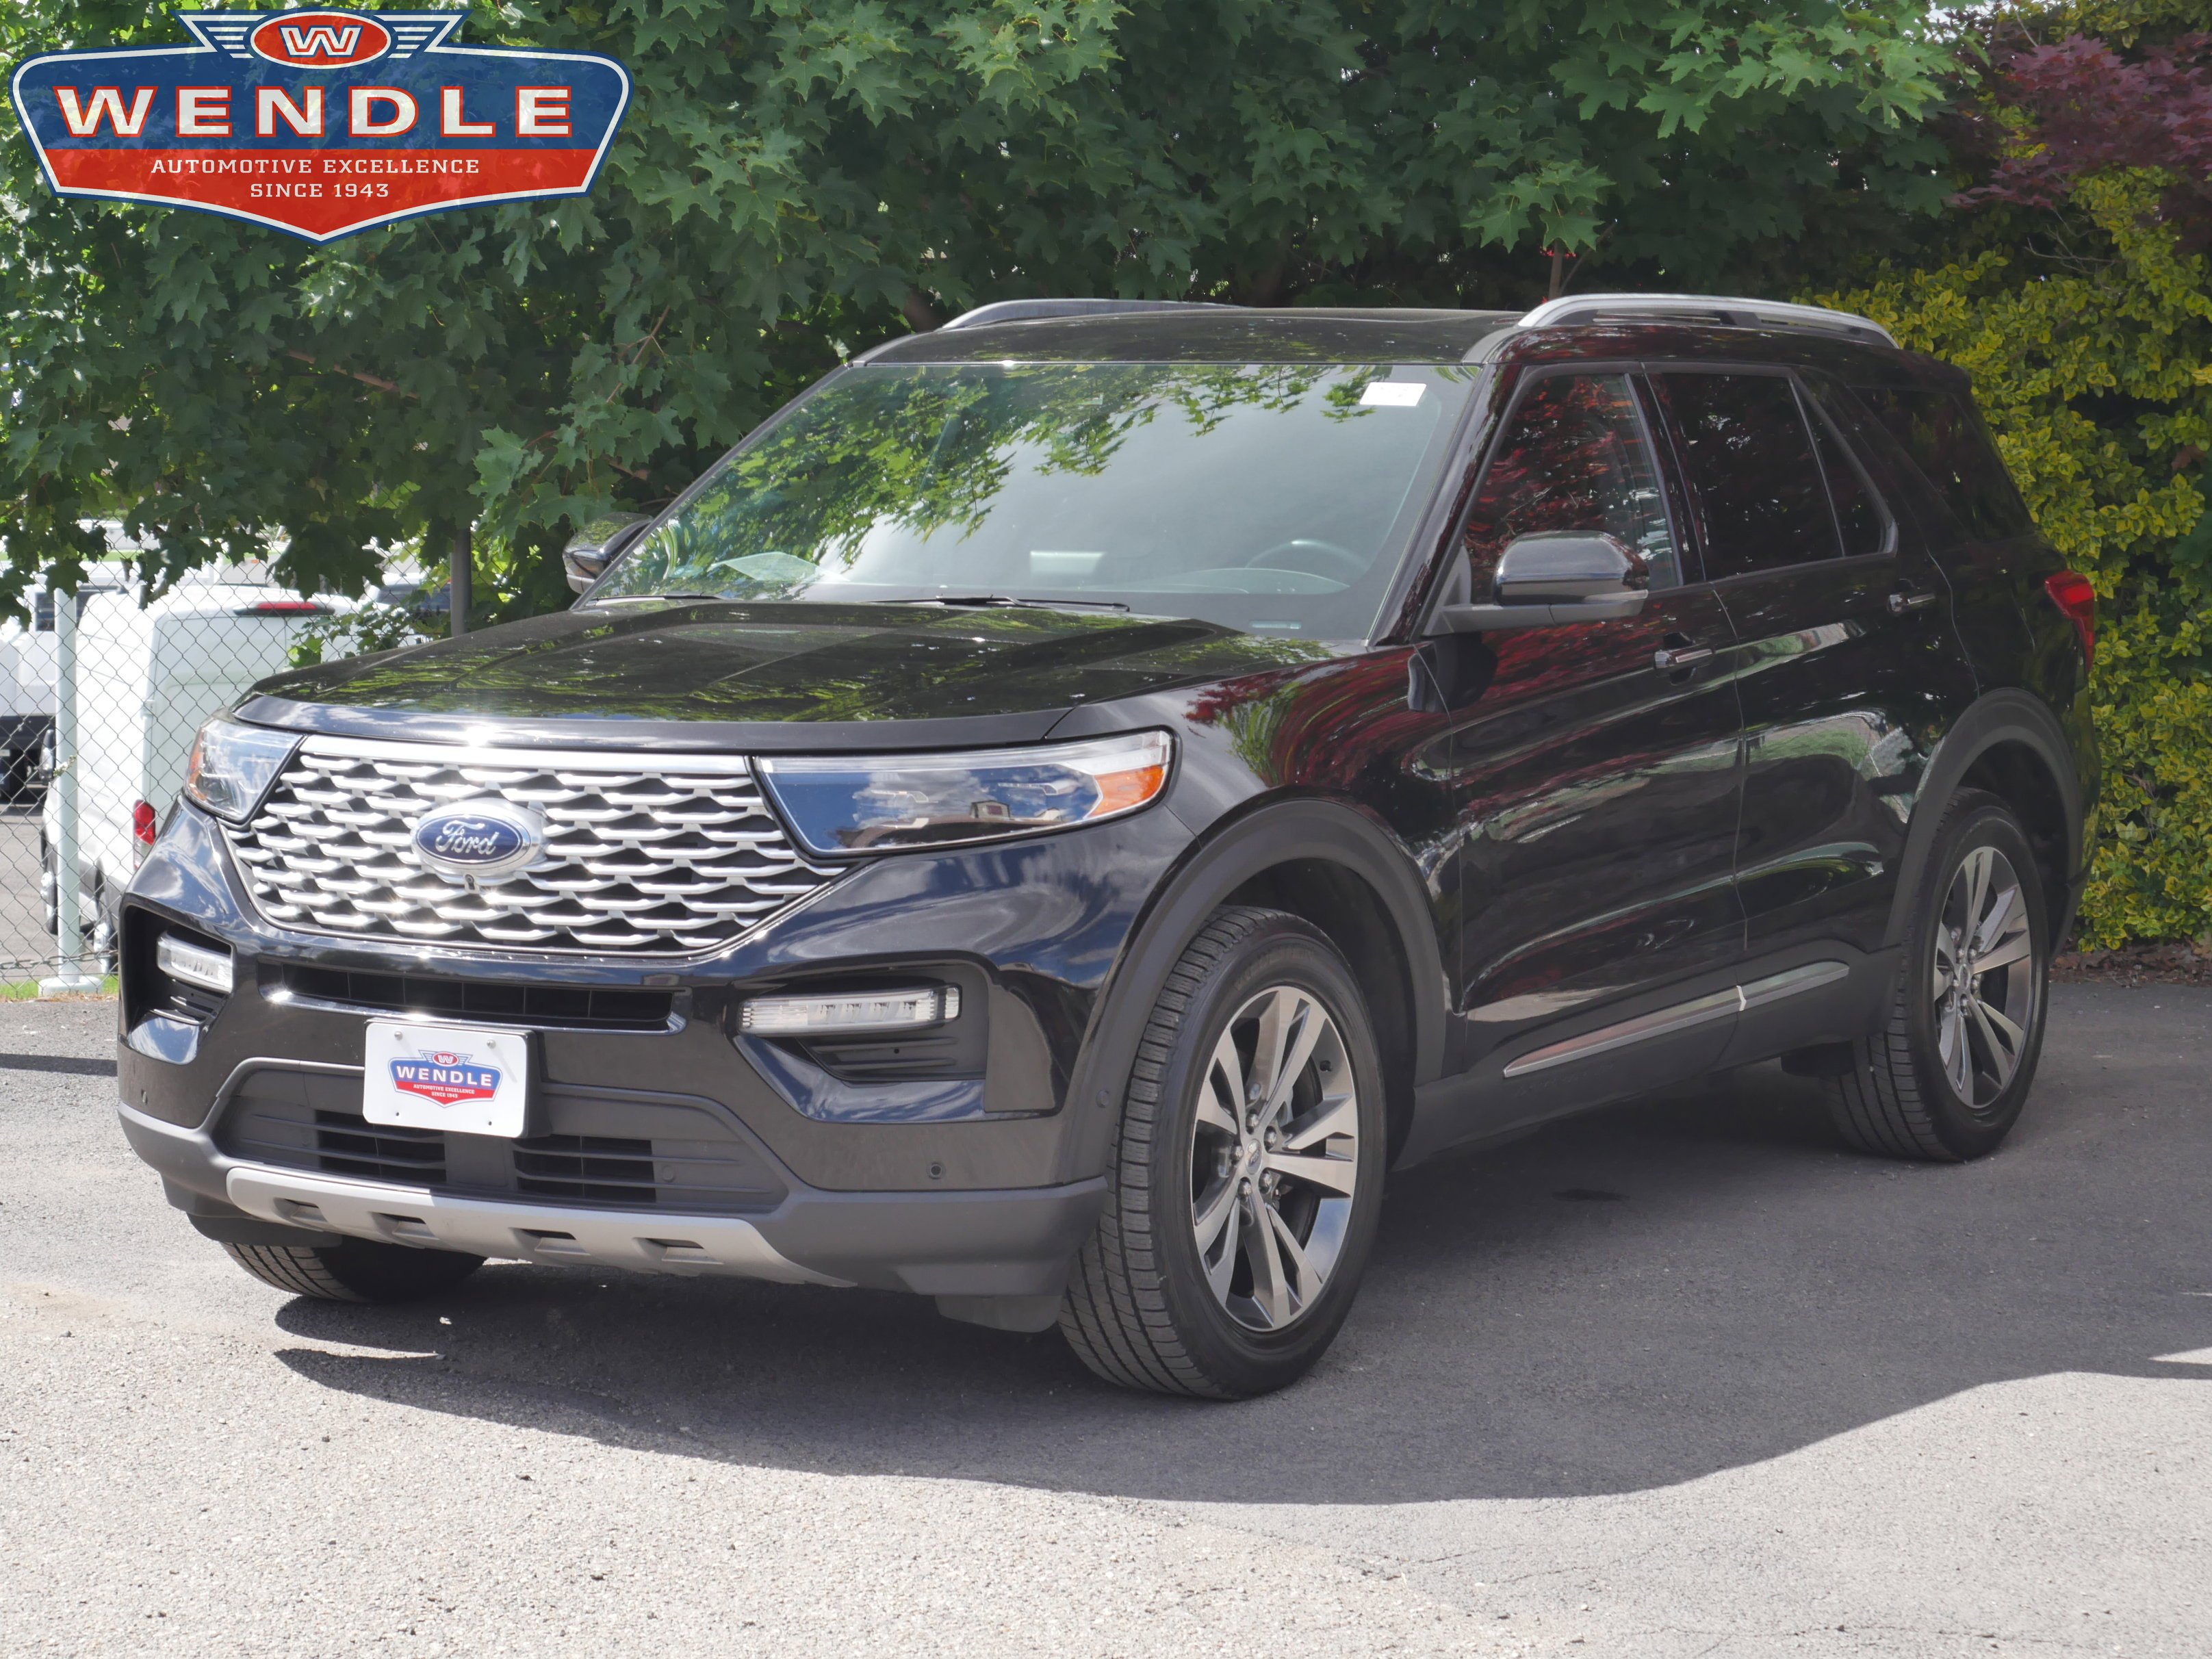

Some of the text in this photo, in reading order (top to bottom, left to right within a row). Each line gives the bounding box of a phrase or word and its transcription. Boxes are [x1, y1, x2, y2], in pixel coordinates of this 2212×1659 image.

[435, 820, 500, 855] Ford
[437, 1054, 454, 1064] W
[396, 1066, 491, 1087] WENDLE
